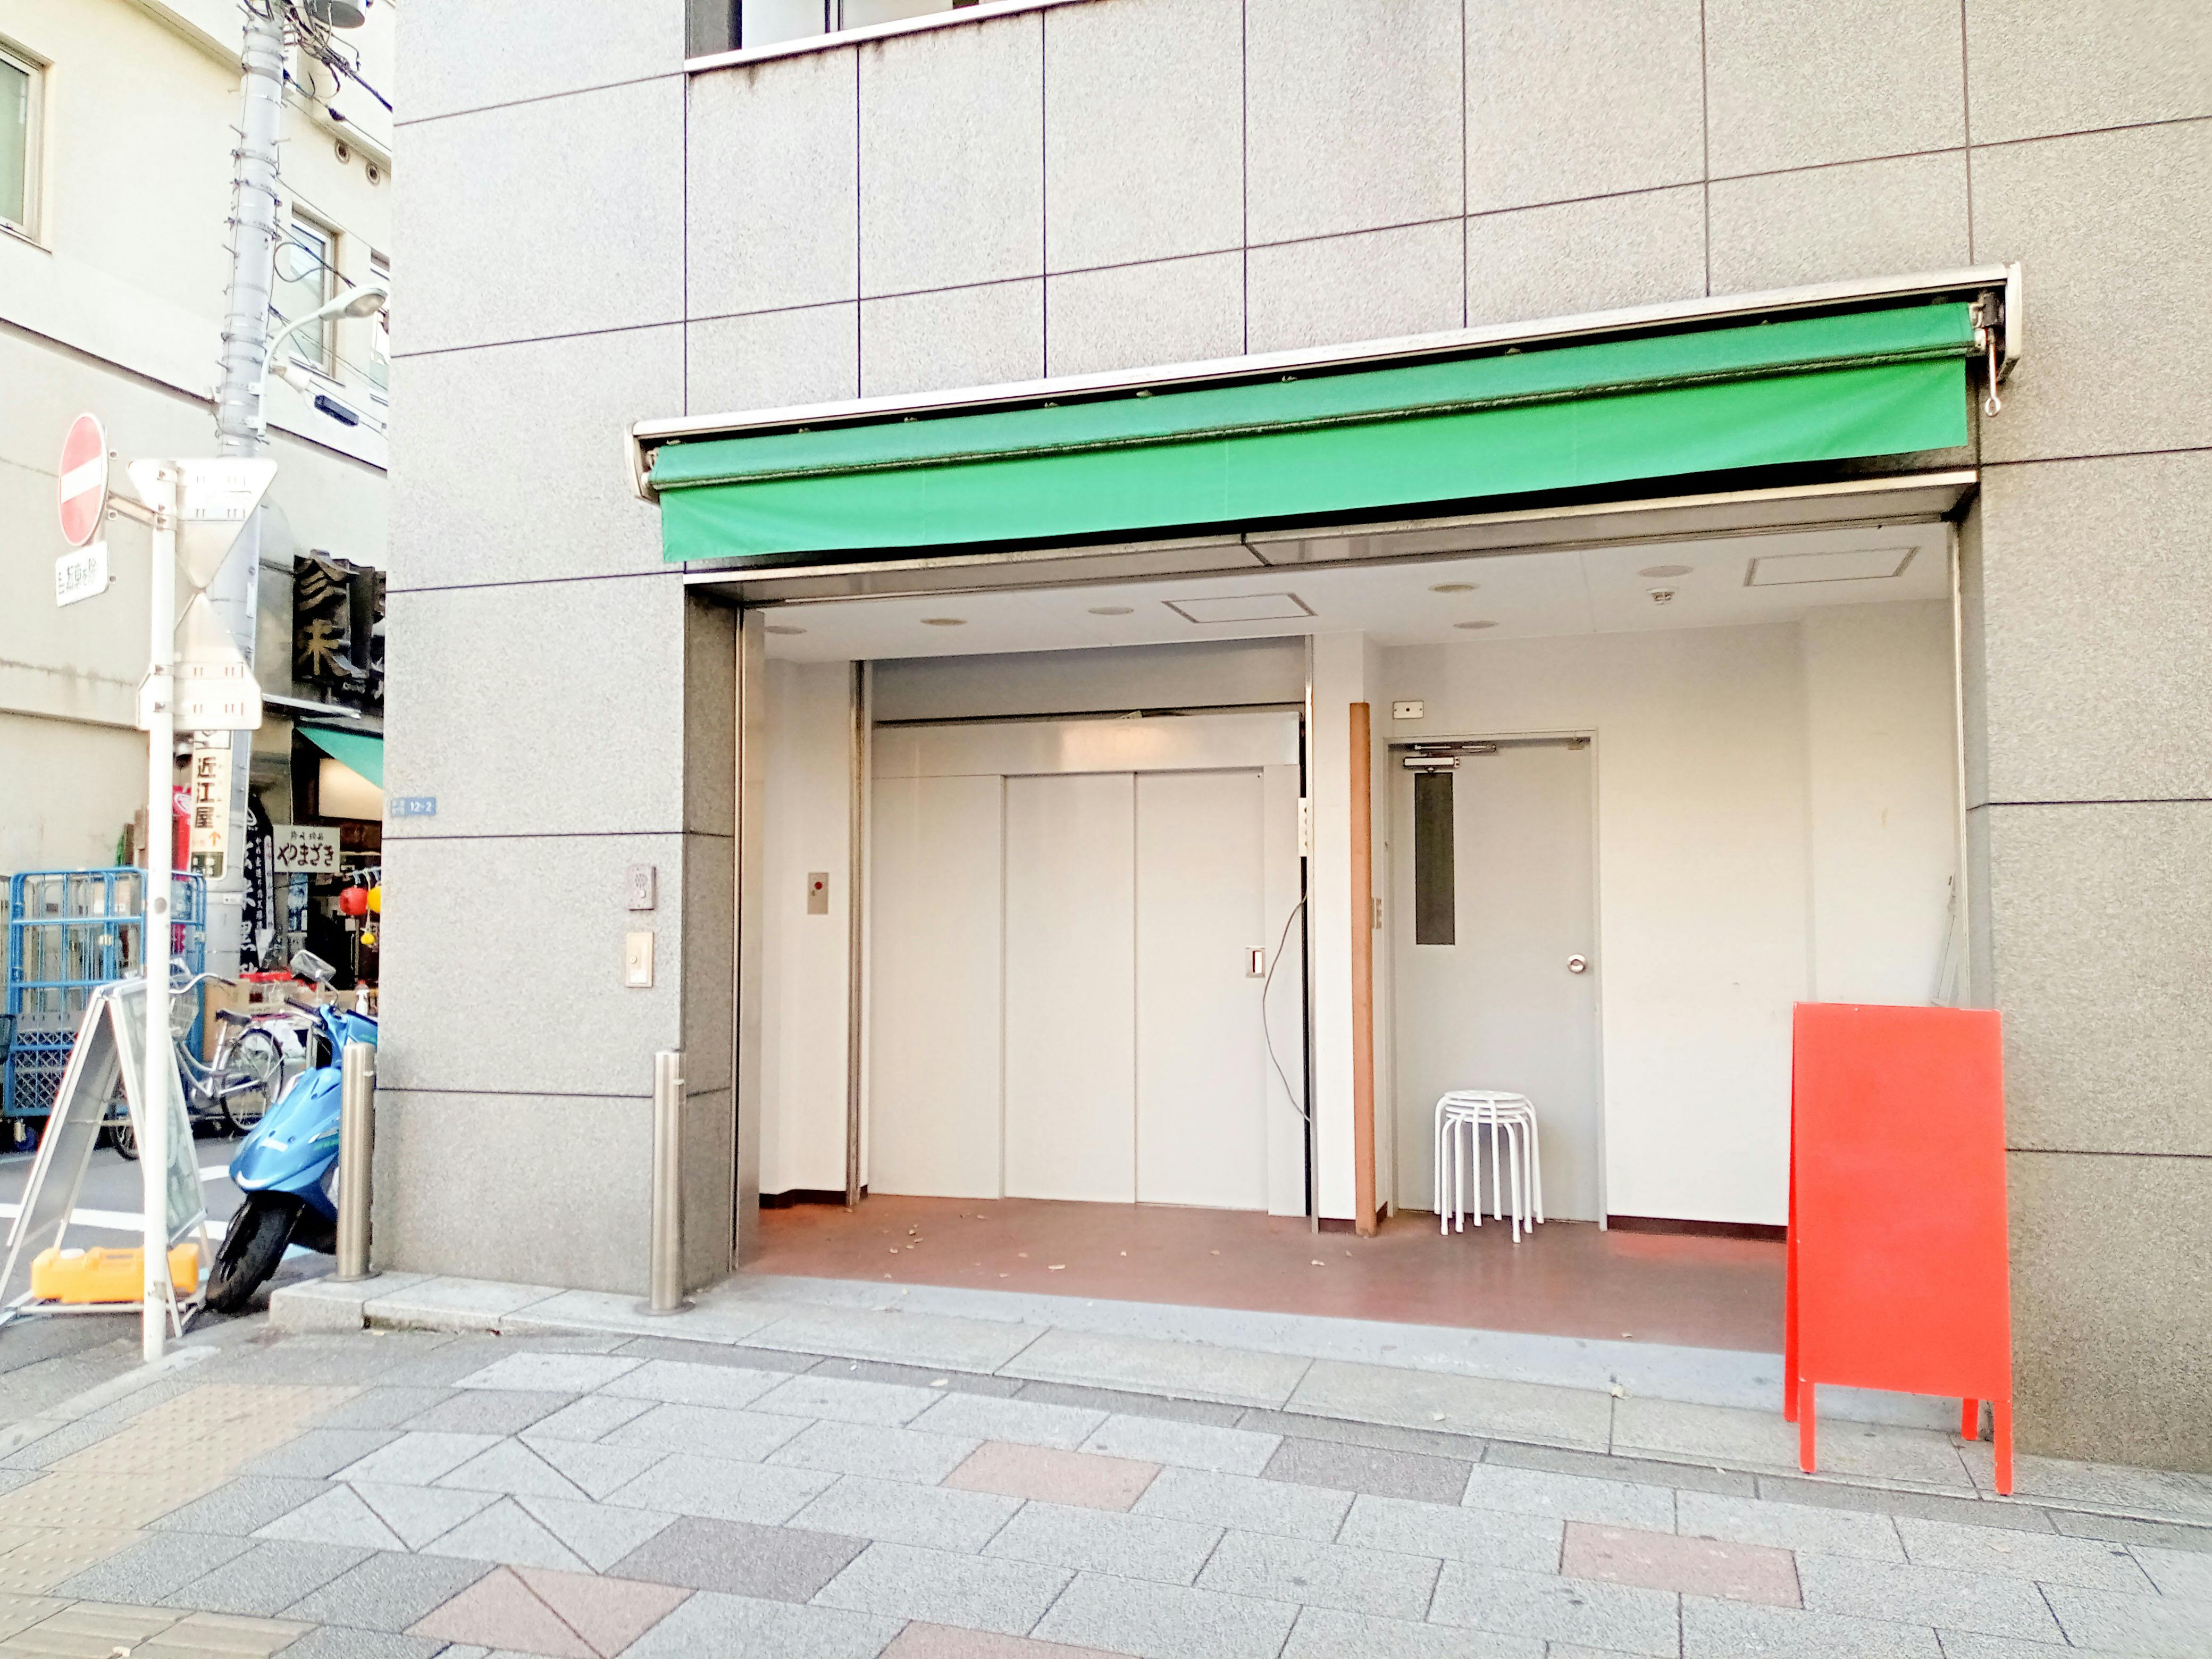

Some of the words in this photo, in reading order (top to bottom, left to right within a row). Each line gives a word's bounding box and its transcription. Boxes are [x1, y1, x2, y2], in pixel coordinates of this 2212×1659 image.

[195, 756, 216, 828] 近江屋
[410, 801, 432, 813] 12-2
[277, 842, 334, 867] やまざき
